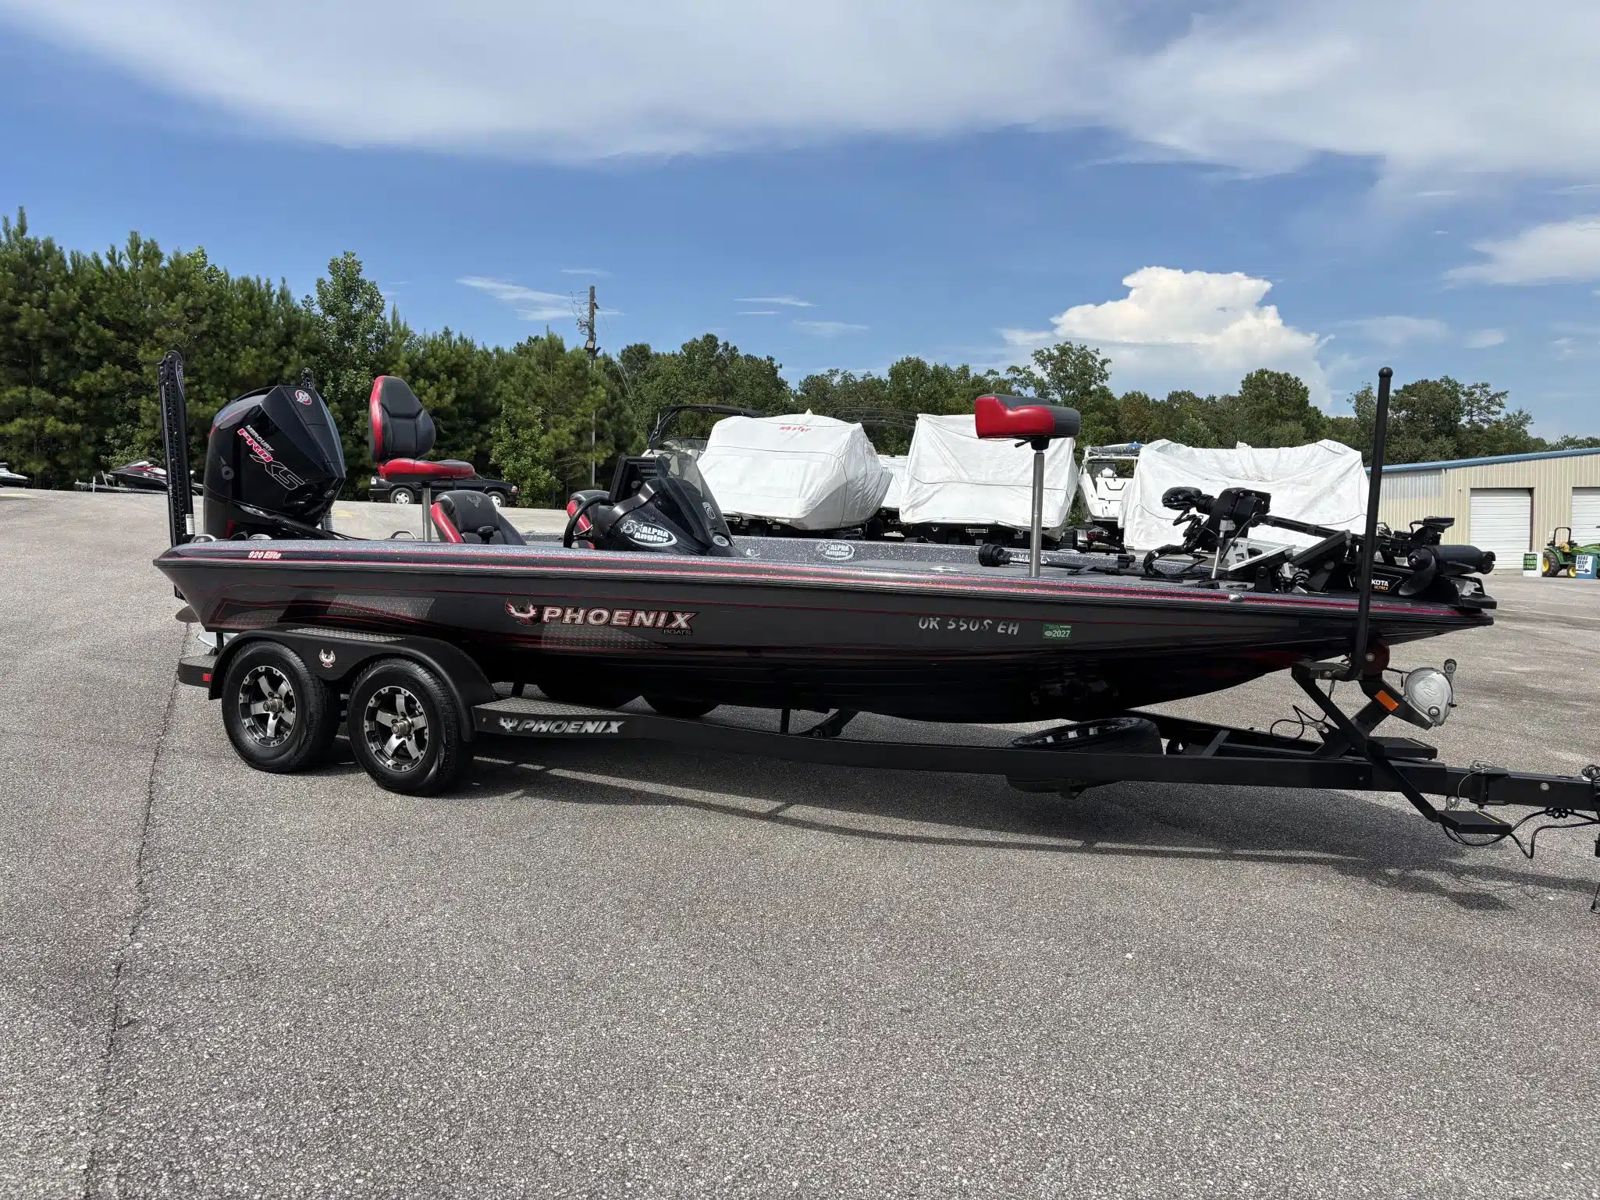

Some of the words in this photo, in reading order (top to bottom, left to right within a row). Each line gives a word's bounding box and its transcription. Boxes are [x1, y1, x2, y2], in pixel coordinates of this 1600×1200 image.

[246, 424, 274, 452] MERCURY
[249, 454, 305, 490] XS
[641, 525, 669, 538] ALPHA
[1371, 579, 1389, 587] KOTA
[542, 606, 697, 629] PHOENIX
[918, 617, 941, 631] OK
[997, 621, 1020, 636] EH
[1051, 629, 1071, 638] 2027
[517, 719, 626, 734] PHOENIX
